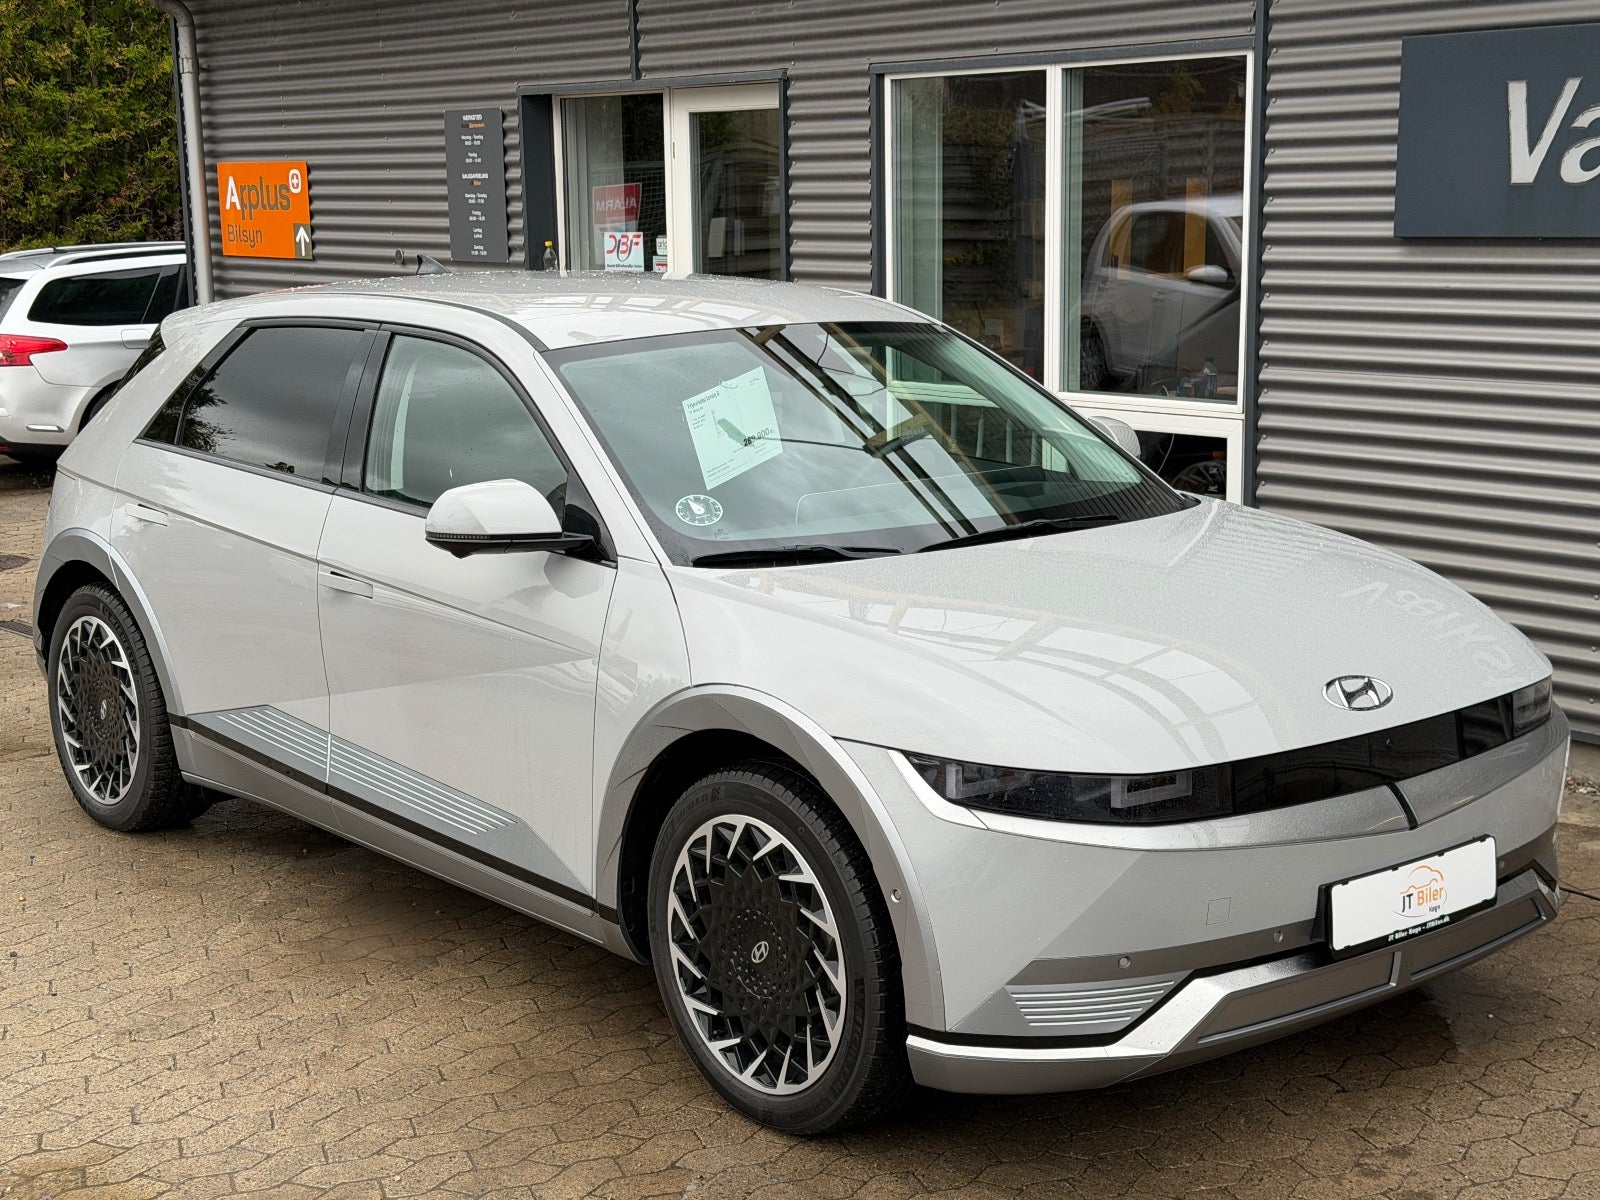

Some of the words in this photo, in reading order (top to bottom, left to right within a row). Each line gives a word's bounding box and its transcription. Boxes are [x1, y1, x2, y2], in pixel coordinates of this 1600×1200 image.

[227, 224, 263, 249] Bilsyn
[1402, 893, 1413, 913] JT
[1417, 887, 1443, 907] Biler
